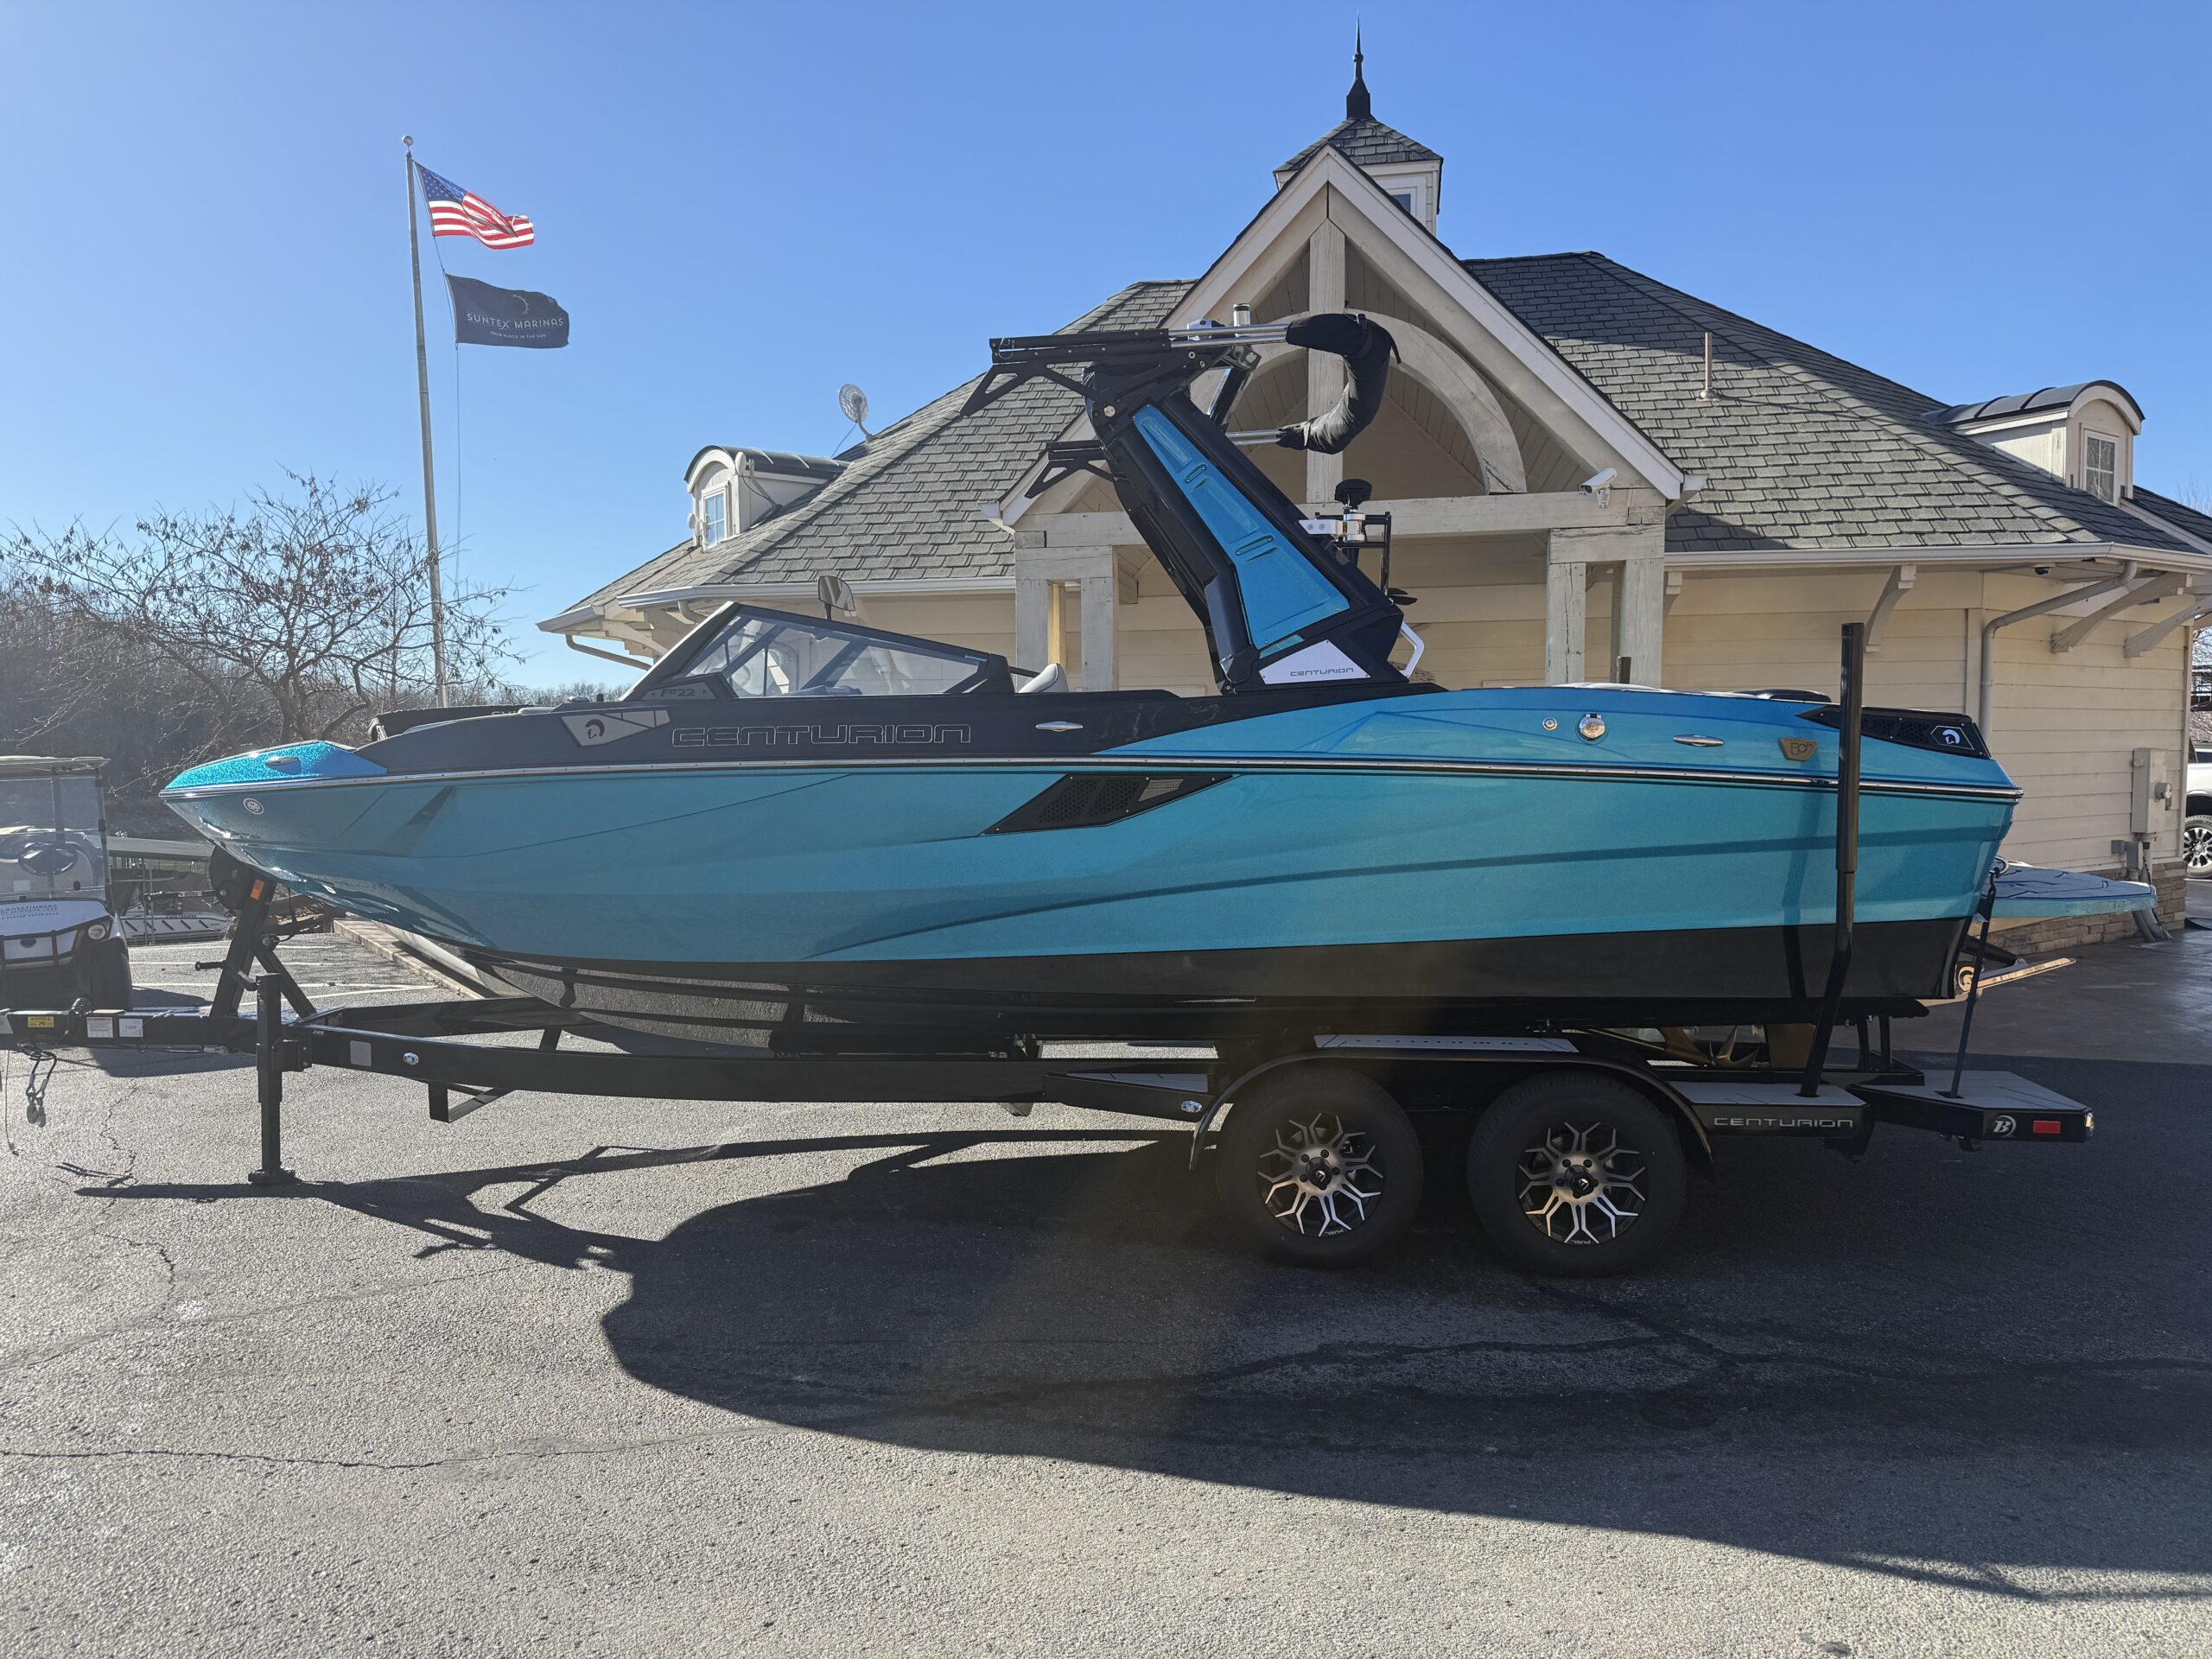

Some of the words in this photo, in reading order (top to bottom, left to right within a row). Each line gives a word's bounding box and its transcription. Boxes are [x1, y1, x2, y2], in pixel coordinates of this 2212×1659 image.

[467, 313, 510, 330] SUNTEX
[514, 318, 563, 328] MARINAS
[1290, 668, 1354, 677] CENTURION
[671, 723, 971, 747] CENTURION
[1714, 1117, 1853, 1128] CENTURION
